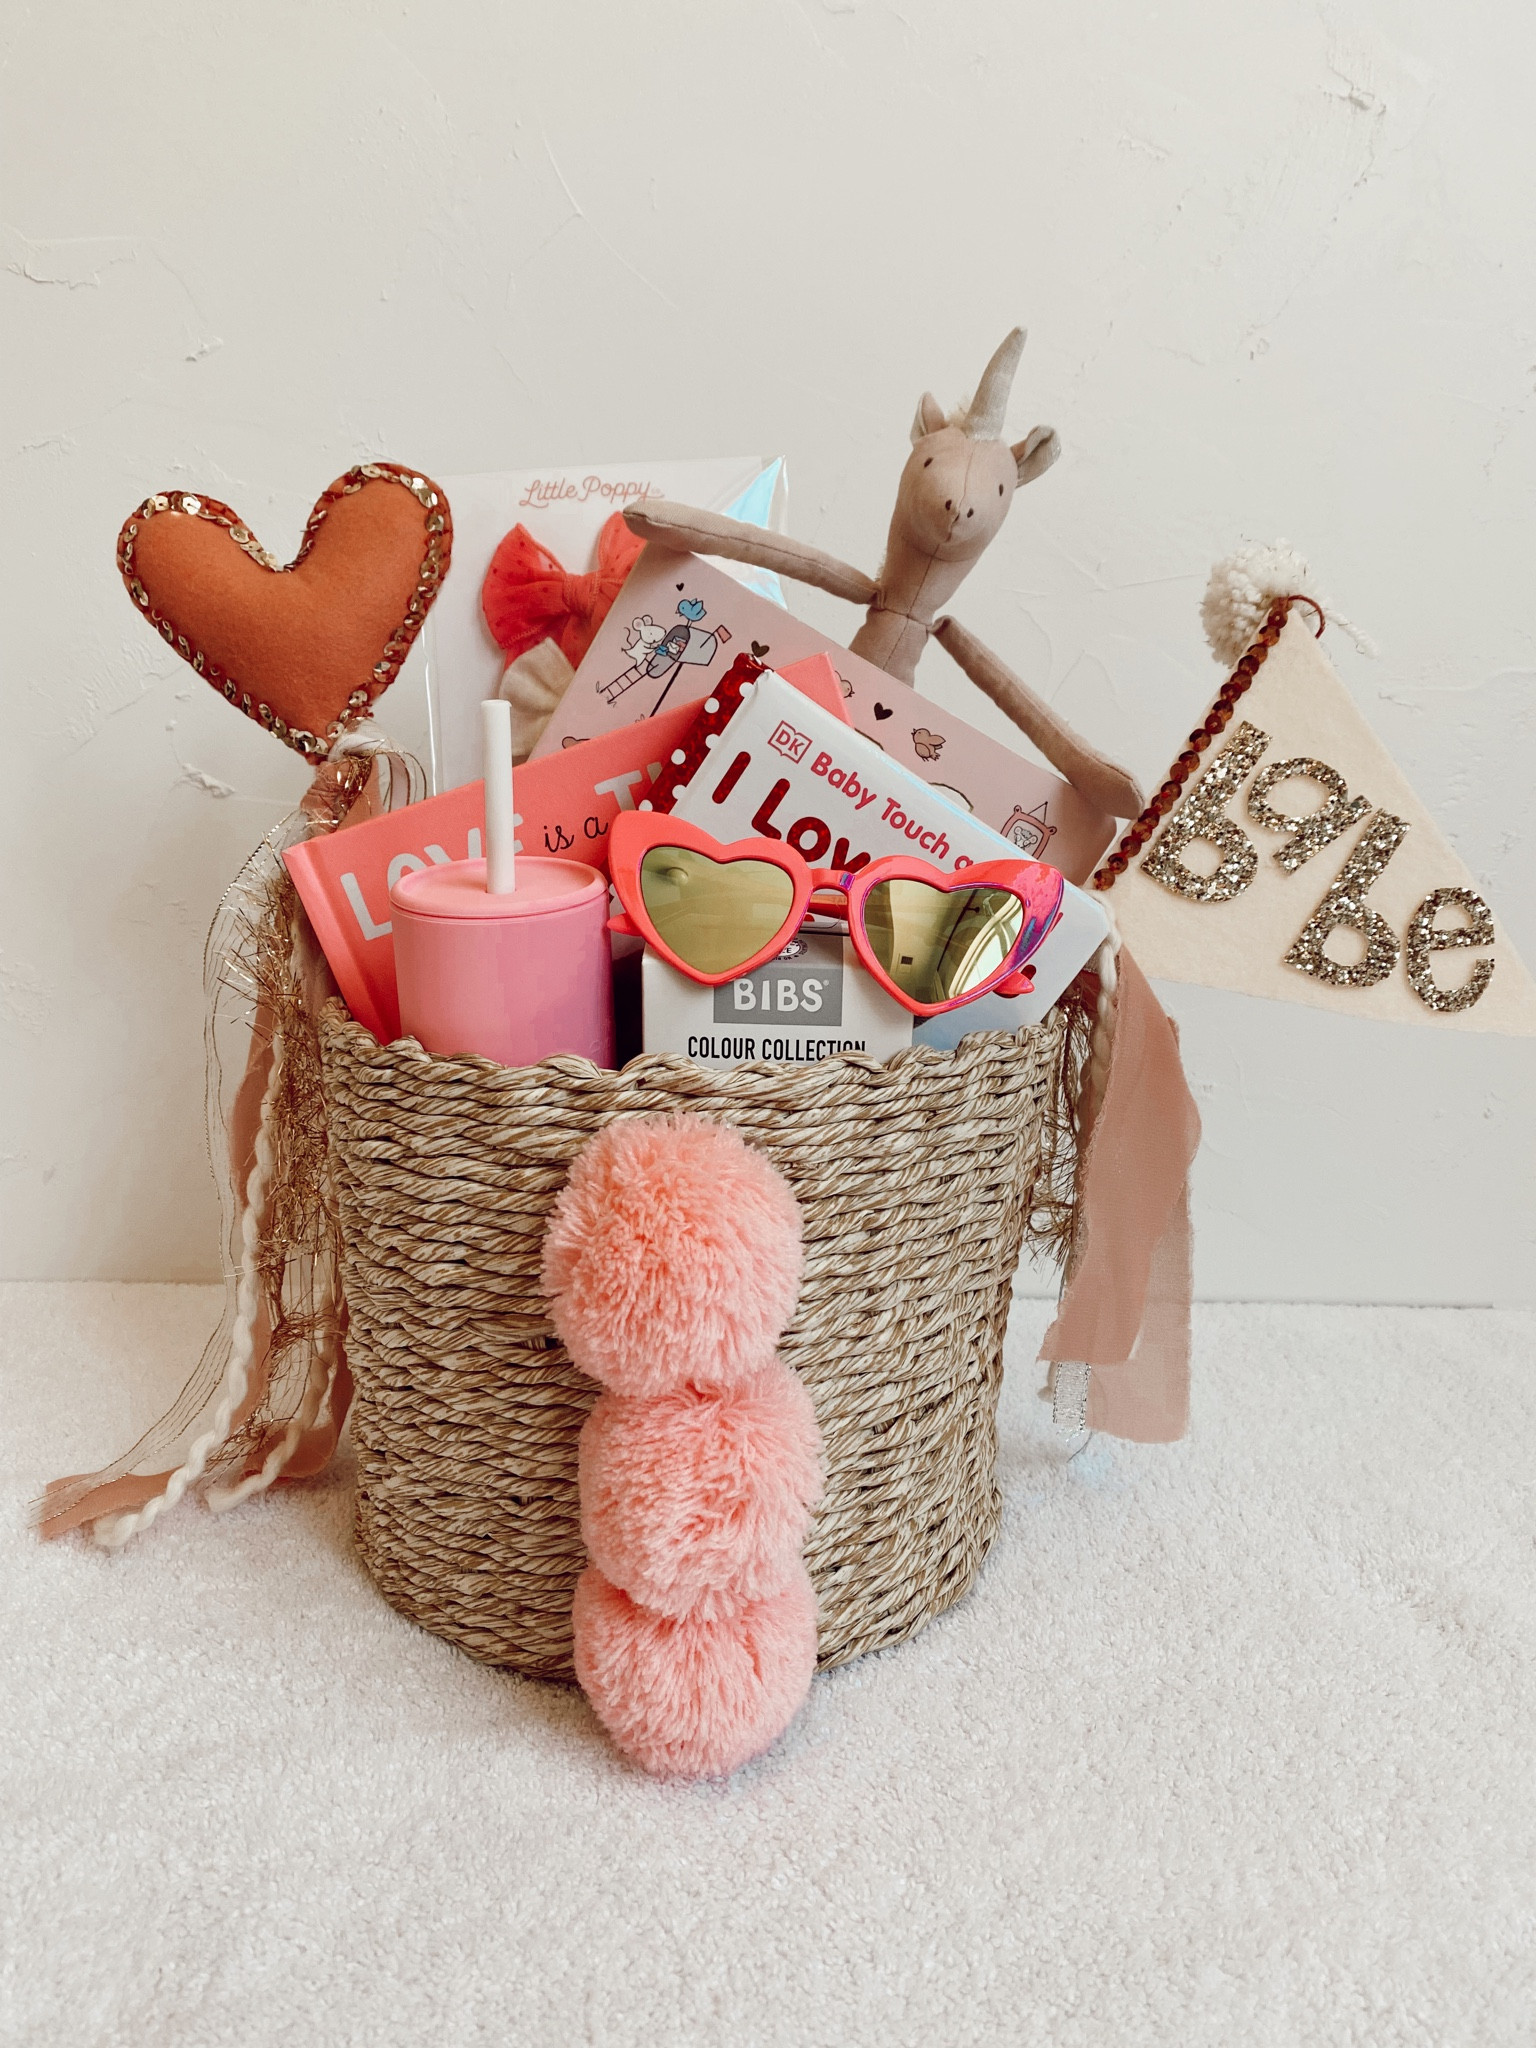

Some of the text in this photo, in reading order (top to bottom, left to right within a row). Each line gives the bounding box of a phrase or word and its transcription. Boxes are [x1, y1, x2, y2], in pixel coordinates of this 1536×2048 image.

[519, 475, 664, 508] Little Poppy
[772, 729, 807, 759] DK
[711, 750, 871, 873] I Lov
[810, 751, 877, 810] Baby
[881, 797, 951, 860] Touch
[544, 824, 575, 853] is
[583, 816, 609, 839] a
[733, 978, 823, 1013] BIBS
[687, 1035, 756, 1060] COLOUR
